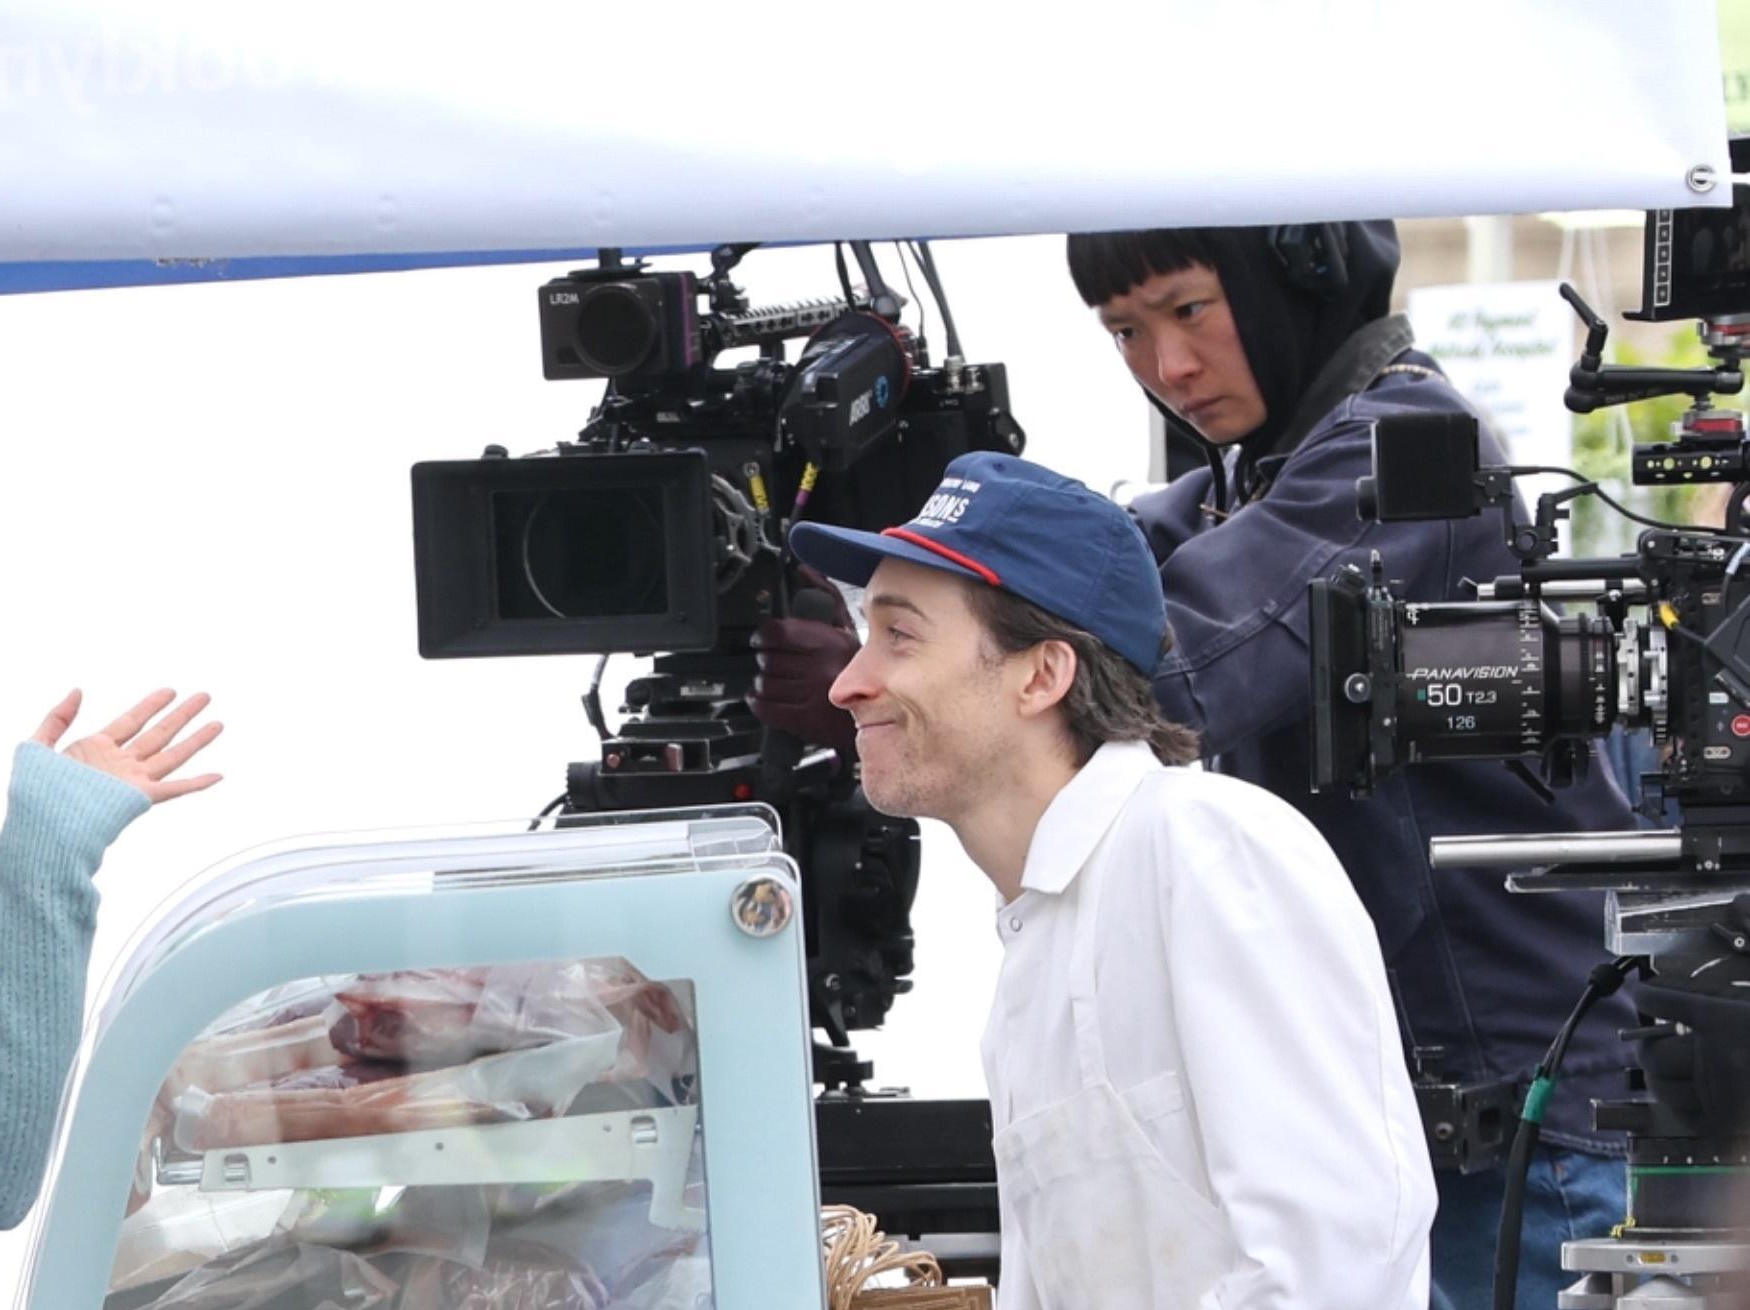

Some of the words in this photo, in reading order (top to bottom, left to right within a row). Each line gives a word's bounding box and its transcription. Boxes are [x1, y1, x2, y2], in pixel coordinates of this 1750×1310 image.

[1406, 666, 1519, 680] PANAVISION
[1427, 683, 1463, 706] 50
[1447, 715, 1476, 729] 126
